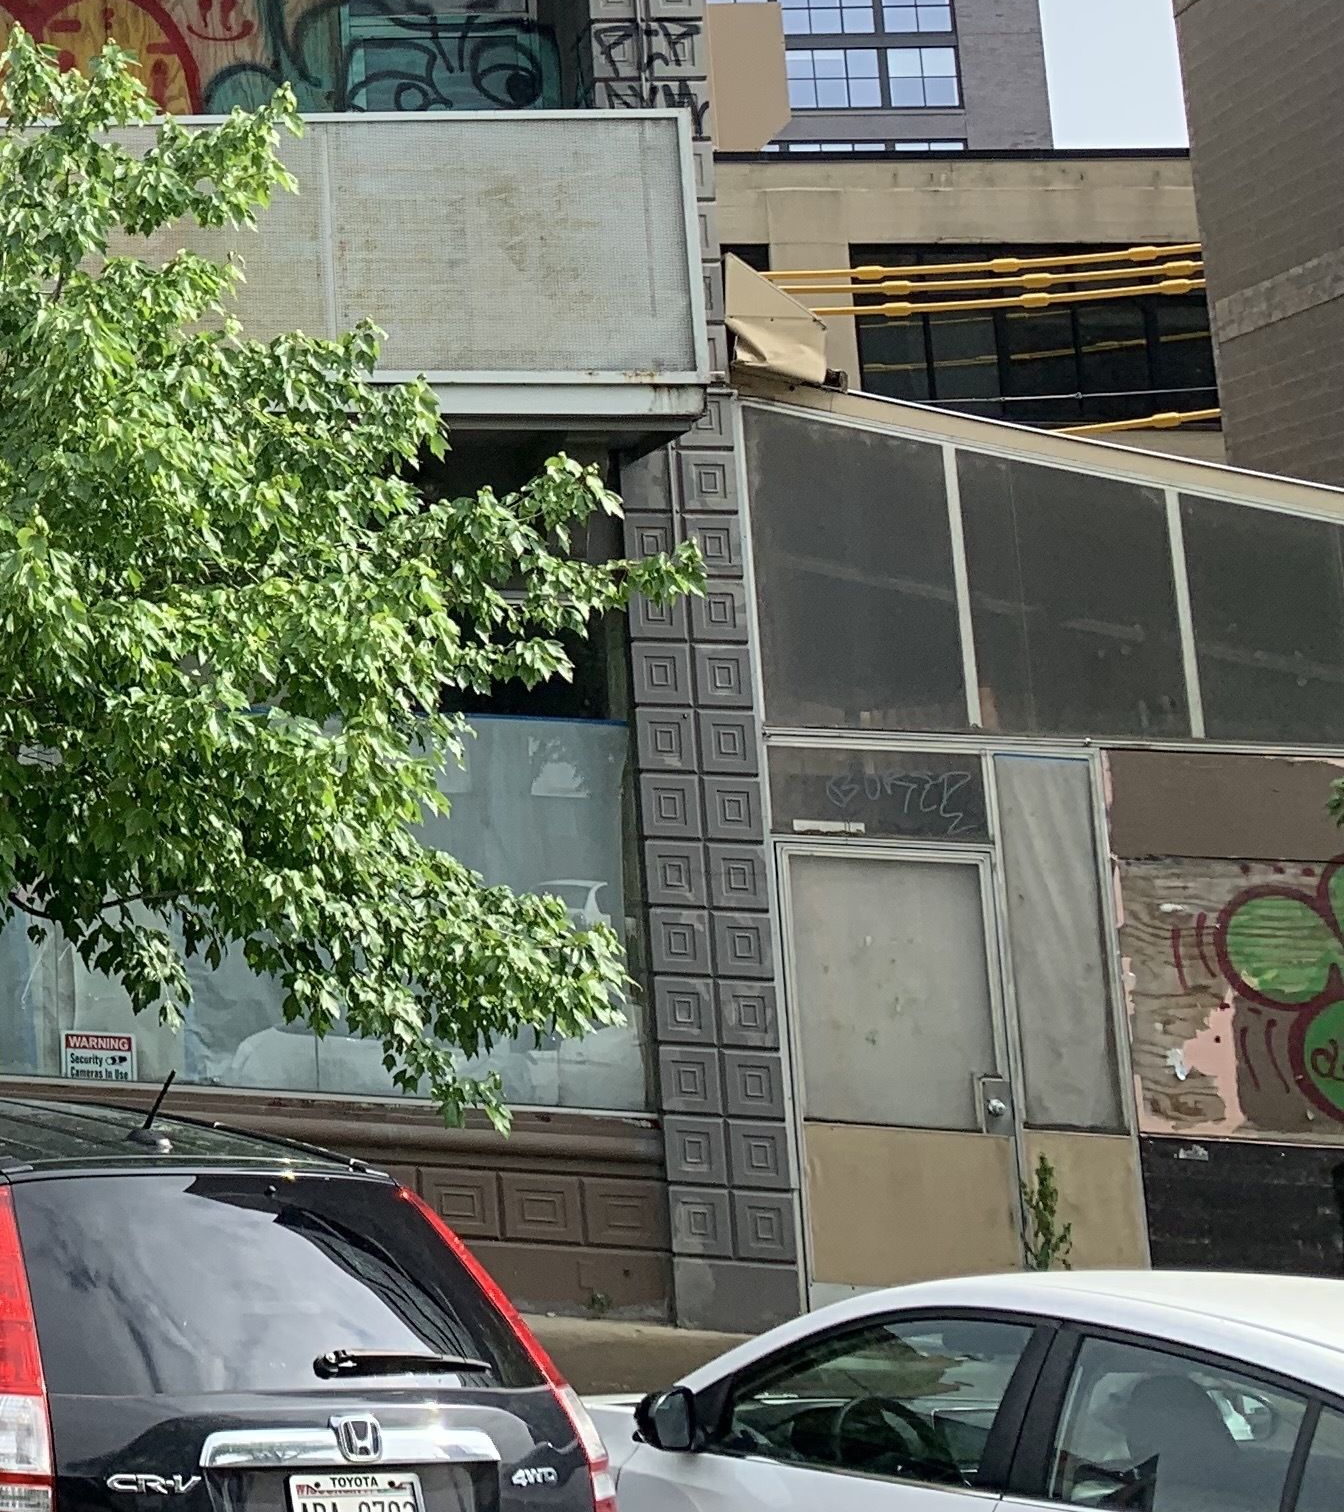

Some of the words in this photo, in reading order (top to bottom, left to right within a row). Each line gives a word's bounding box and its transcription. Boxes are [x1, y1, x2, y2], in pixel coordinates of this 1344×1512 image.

[68, 1035, 129, 1051] WARNING
[70, 1052, 103, 1067] Security
[70, 1067, 103, 1078] Cameras
[105, 1068, 113, 1080] In
[115, 1068, 128, 1080] Use
[106, 1473, 202, 1495] CR-V
[329, 1476, 379, 1489] TOYOTA
[511, 1467, 558, 1487] 4WD
